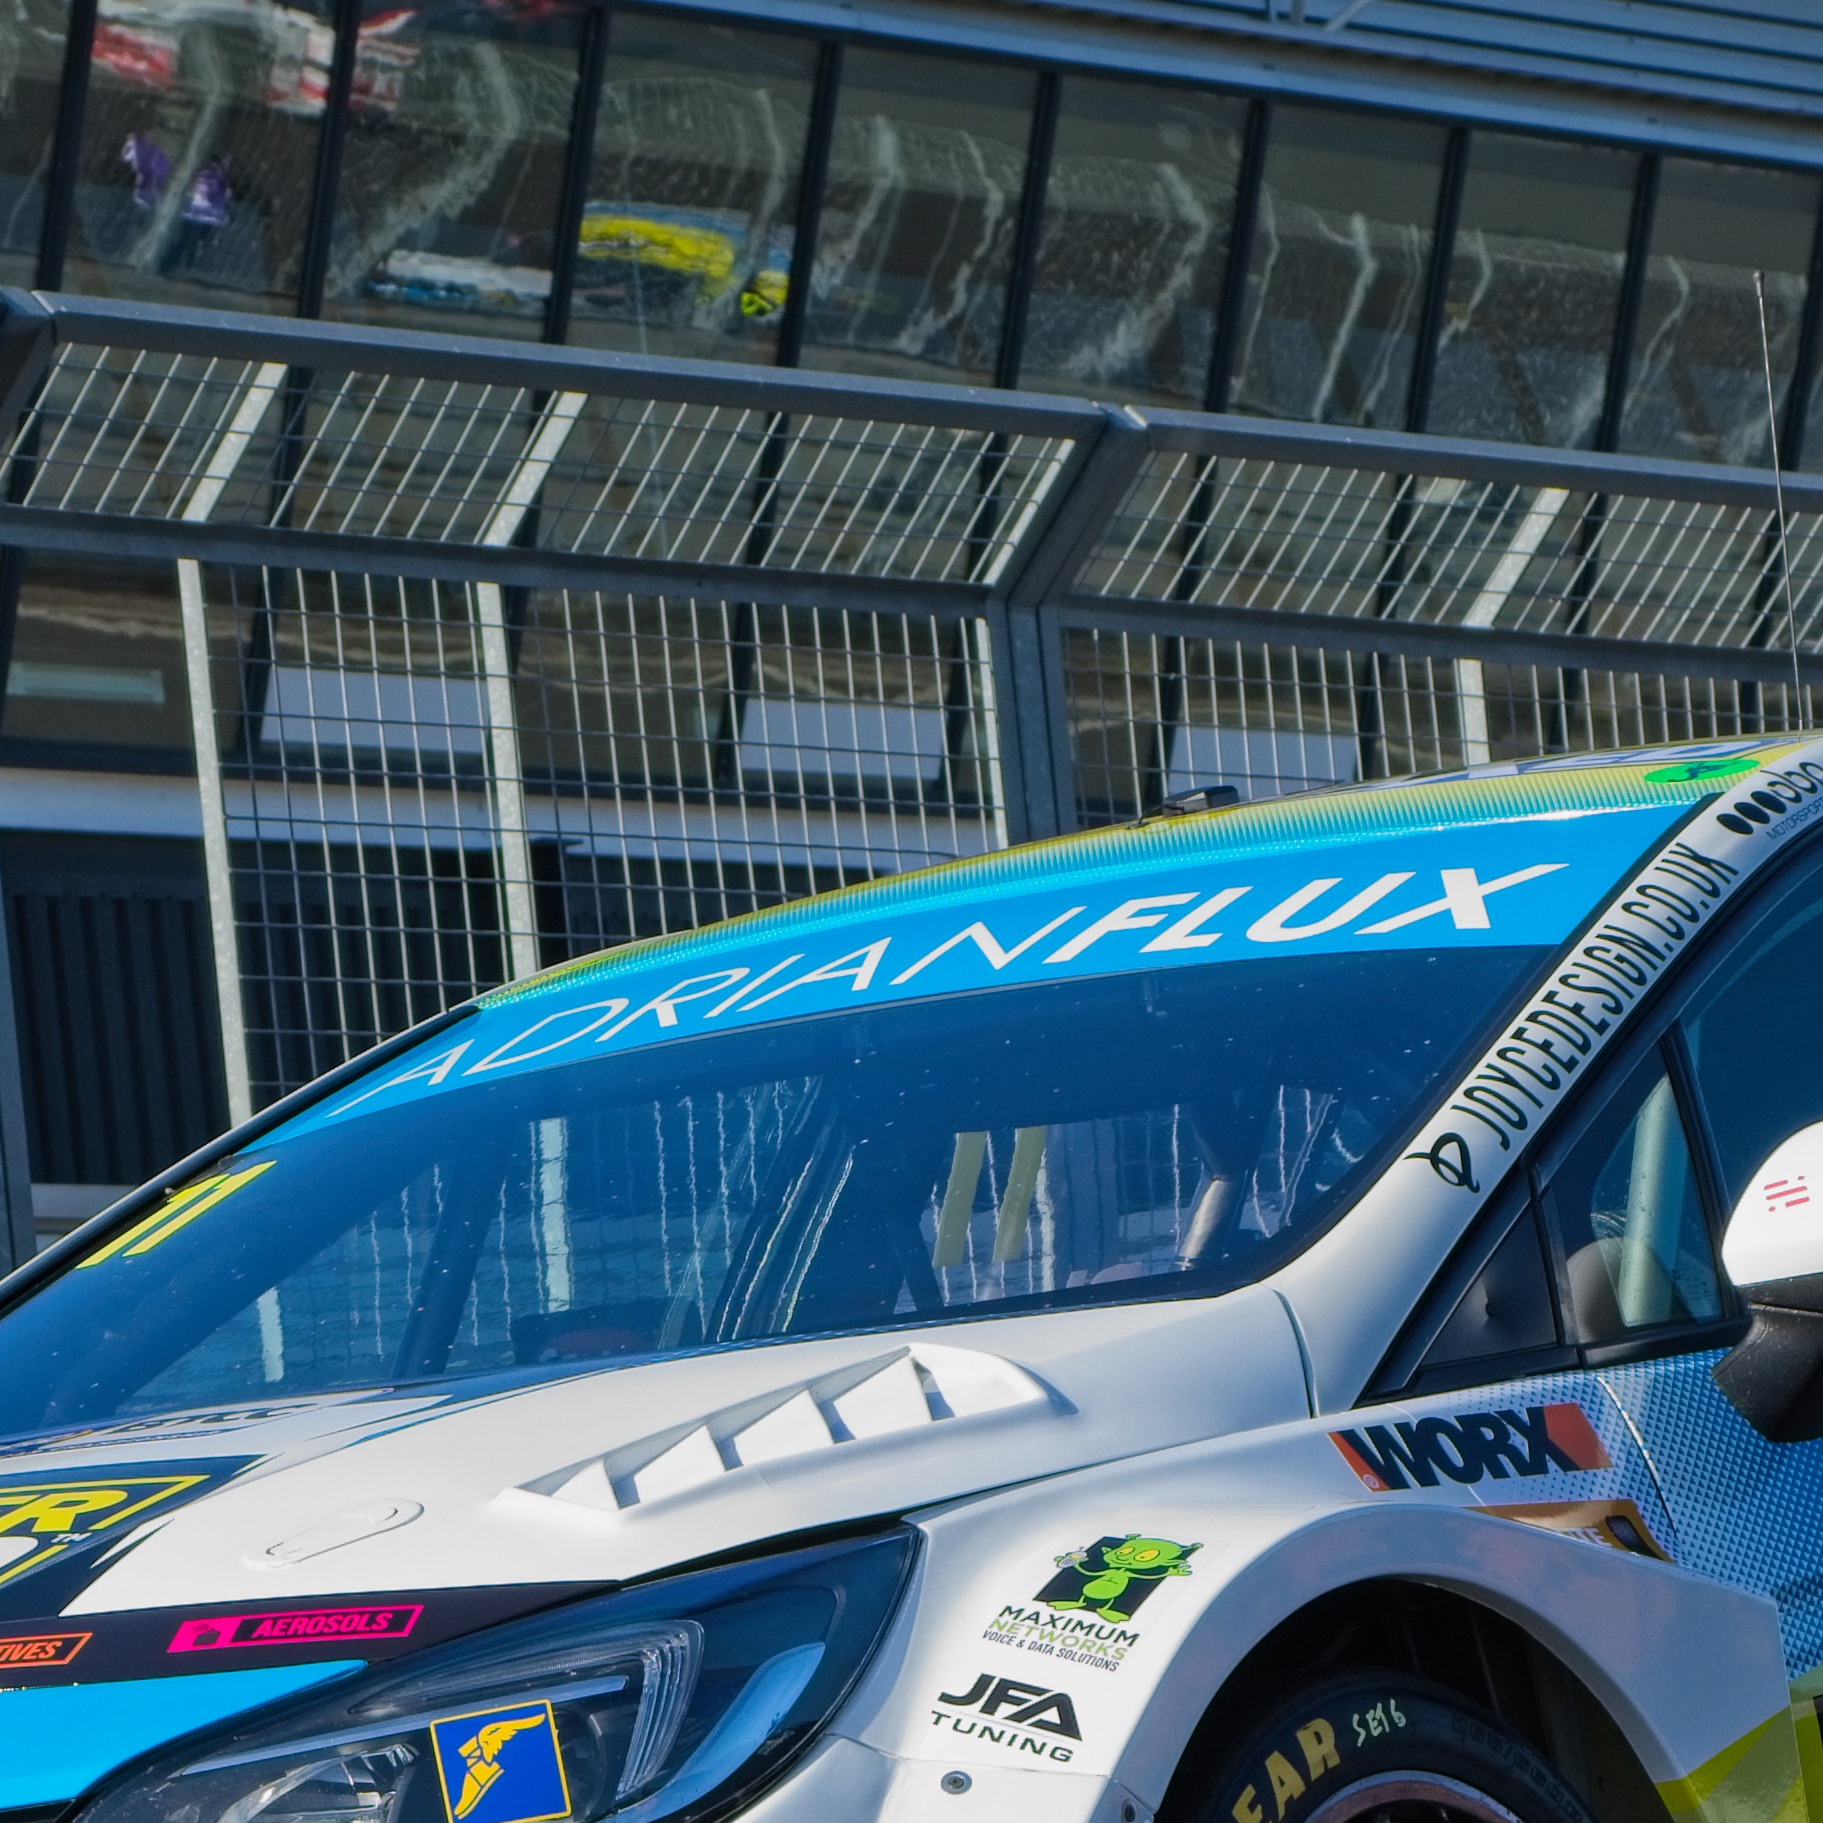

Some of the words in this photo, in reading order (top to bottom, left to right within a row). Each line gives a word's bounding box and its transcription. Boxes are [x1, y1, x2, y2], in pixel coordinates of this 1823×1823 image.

[1450, 842, 1739, 1151] JOYCEDESIGN.CO.UK
[1336, 1405, 1583, 1491] WORX
[252, 1611, 394, 1639] AEROSOLS
[988, 1618, 1129, 1661] NETWORKS
[998, 1605, 1141, 1648] MAXIMUM
[982, 1629, 1019, 1647] VOICE
[1028, 1640, 1055, 1656] DATA
[1056, 1647, 1120, 1672] SOLUTIONS
[937, 1672, 1083, 1742] JFA
[931, 1709, 1074, 1763] TUNING
